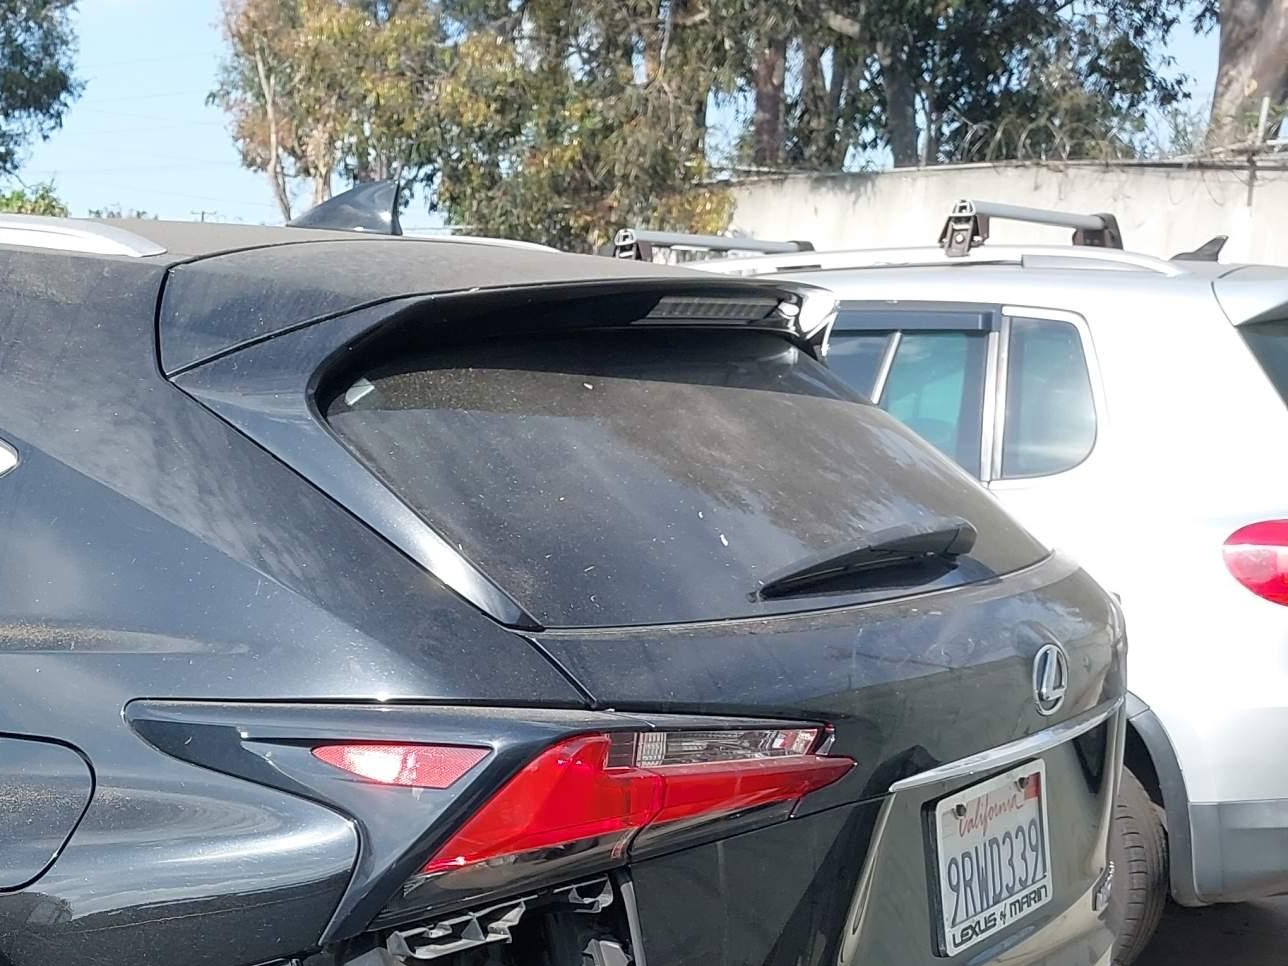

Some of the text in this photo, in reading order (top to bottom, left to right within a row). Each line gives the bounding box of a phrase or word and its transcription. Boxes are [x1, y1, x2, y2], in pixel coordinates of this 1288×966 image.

[958, 792, 1024, 838] California
[947, 817, 1040, 929] 9RWD339
[951, 912, 998, 949] LEXUS
[1009, 884, 1049, 919] MARIN
